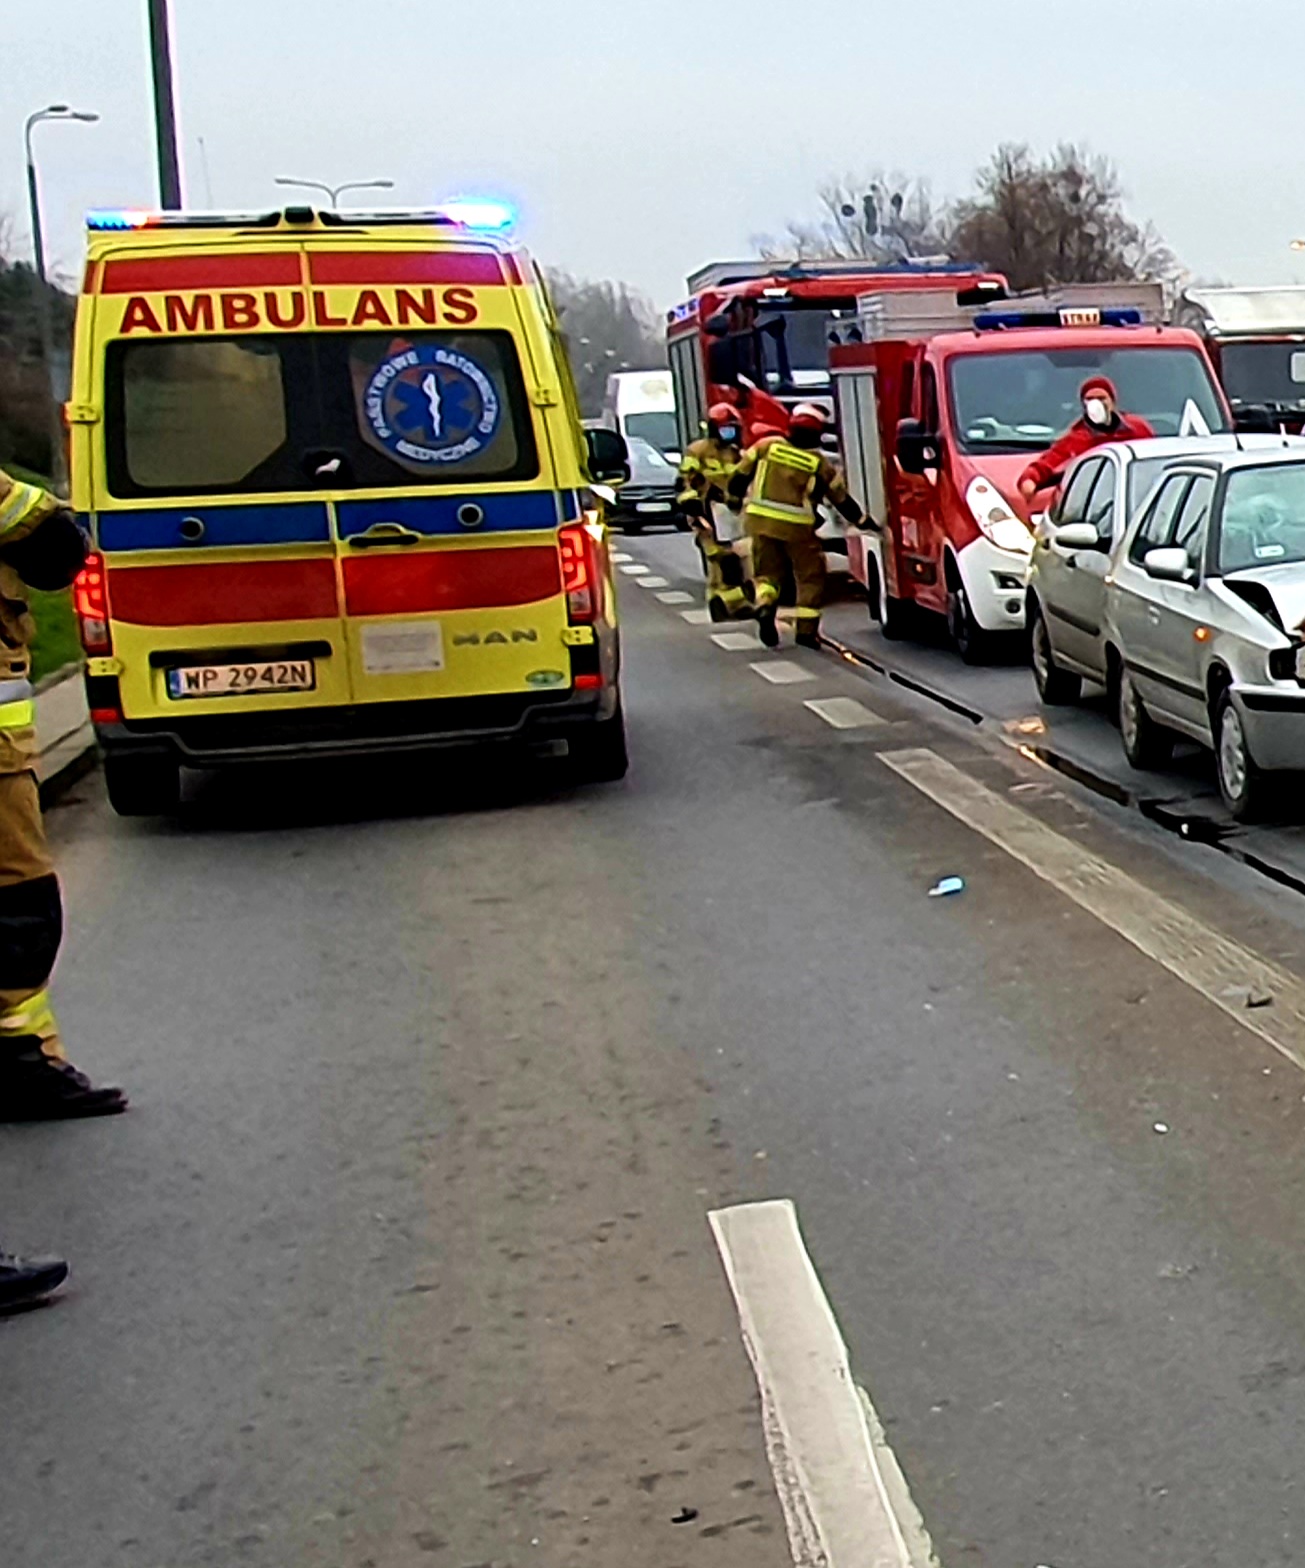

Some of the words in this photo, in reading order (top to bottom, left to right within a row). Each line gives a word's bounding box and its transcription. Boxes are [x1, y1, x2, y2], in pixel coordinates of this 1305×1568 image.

[119, 288, 479, 334] AMBULANS
[185, 668, 219, 690] WP
[228, 663, 307, 688] 2942N
